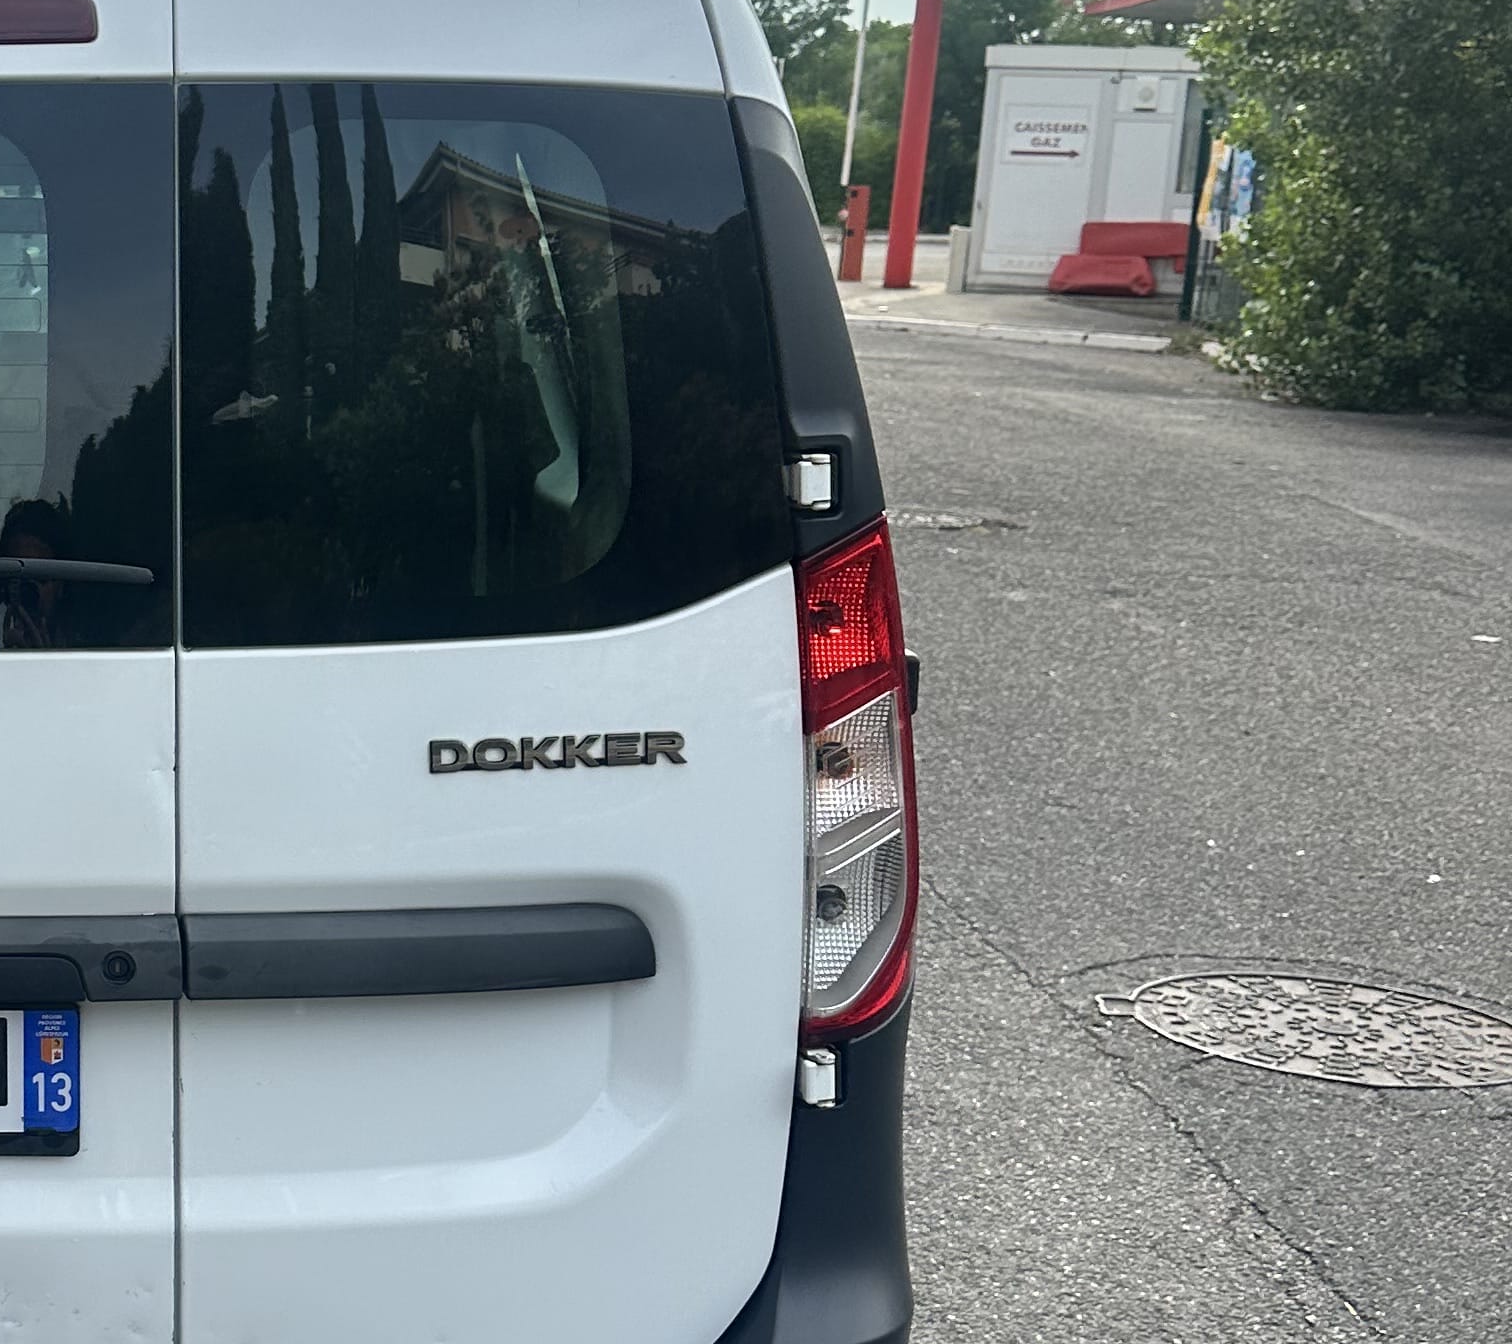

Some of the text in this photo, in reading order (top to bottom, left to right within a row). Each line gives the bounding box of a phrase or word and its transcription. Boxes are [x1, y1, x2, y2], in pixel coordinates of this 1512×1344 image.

[1031, 137, 1062, 148] GAZ
[429, 731, 687, 774] DOKKER
[32, 1072, 73, 1113] 13
